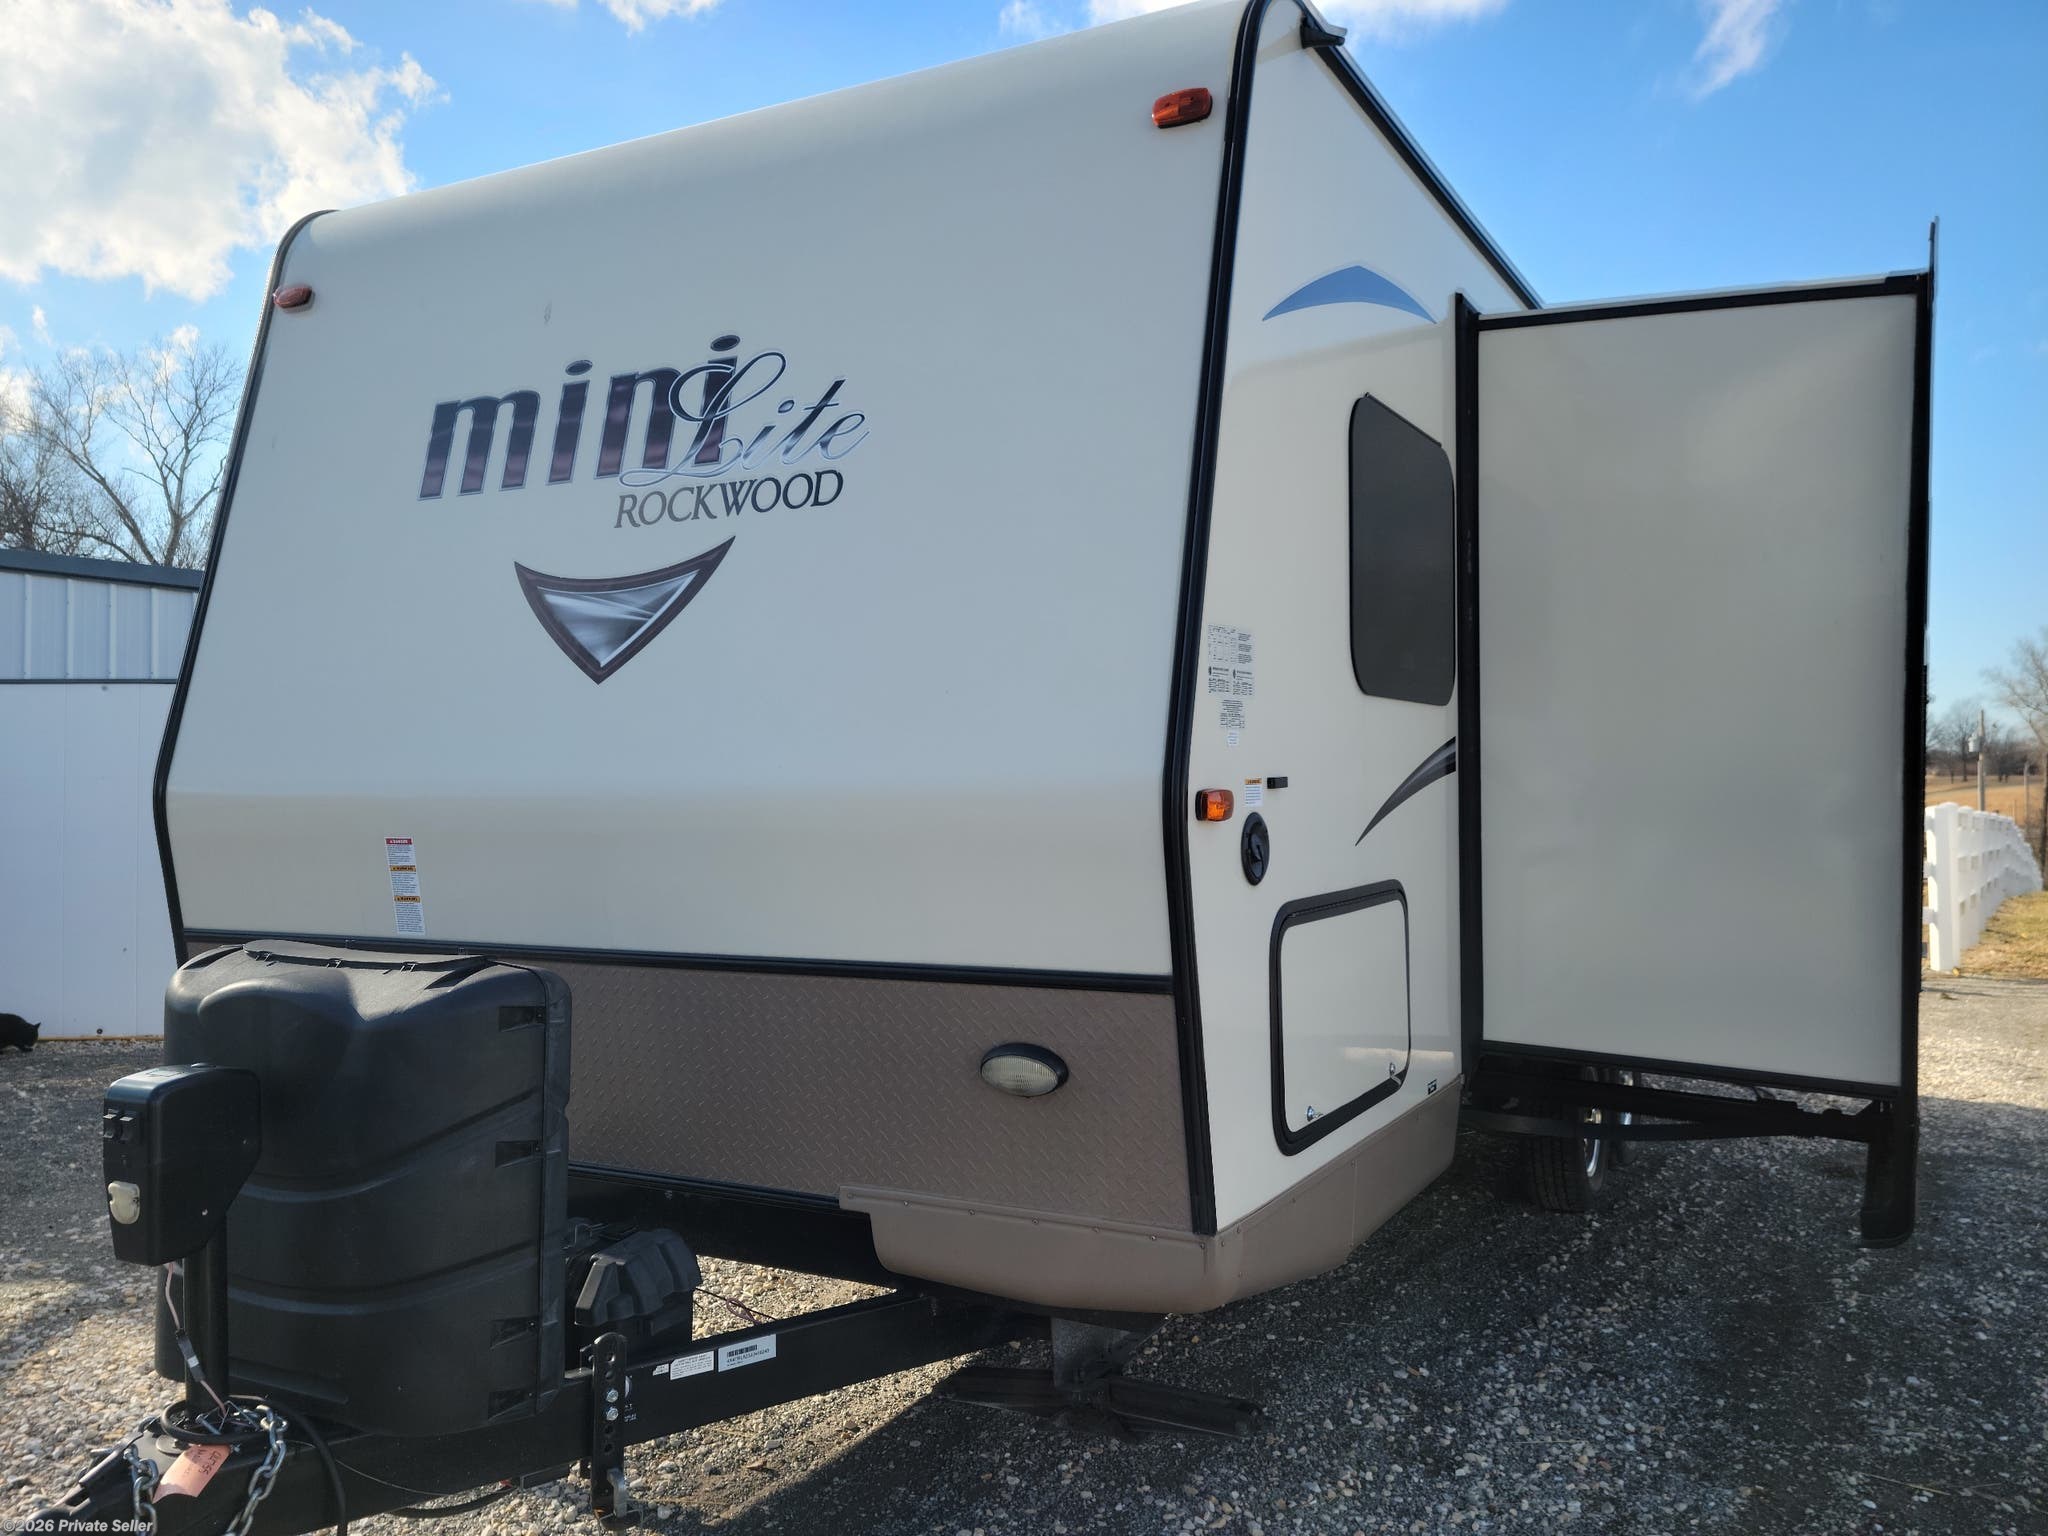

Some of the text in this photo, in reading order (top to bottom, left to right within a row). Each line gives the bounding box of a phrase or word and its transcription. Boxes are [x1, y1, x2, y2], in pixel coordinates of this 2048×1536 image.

[418, 335, 870, 500] mini Lite
[614, 469, 844, 528] ROCKWOOD
